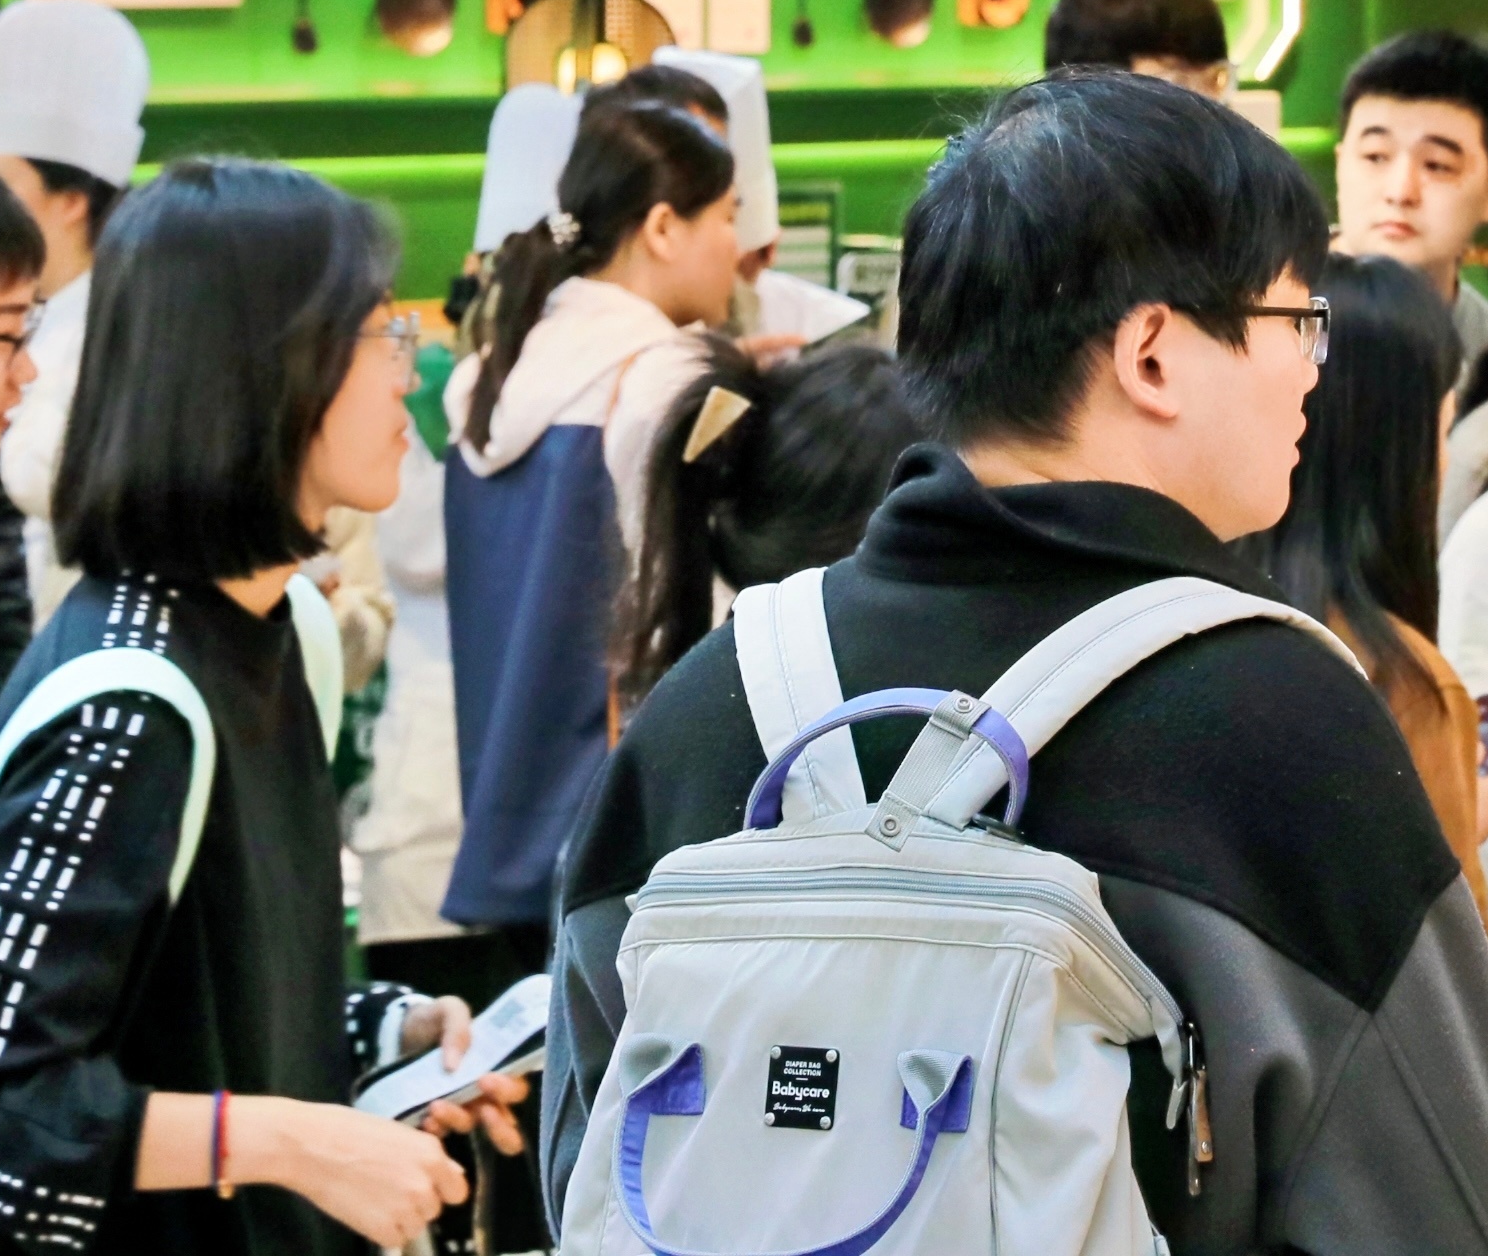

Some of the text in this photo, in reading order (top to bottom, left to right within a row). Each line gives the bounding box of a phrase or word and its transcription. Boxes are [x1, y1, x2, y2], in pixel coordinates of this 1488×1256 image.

[785, 1060, 821, 1069] DIAPER BAG
[783, 1068, 822, 1077] COLLECTION
[771, 1080, 830, 1101] Babycare
